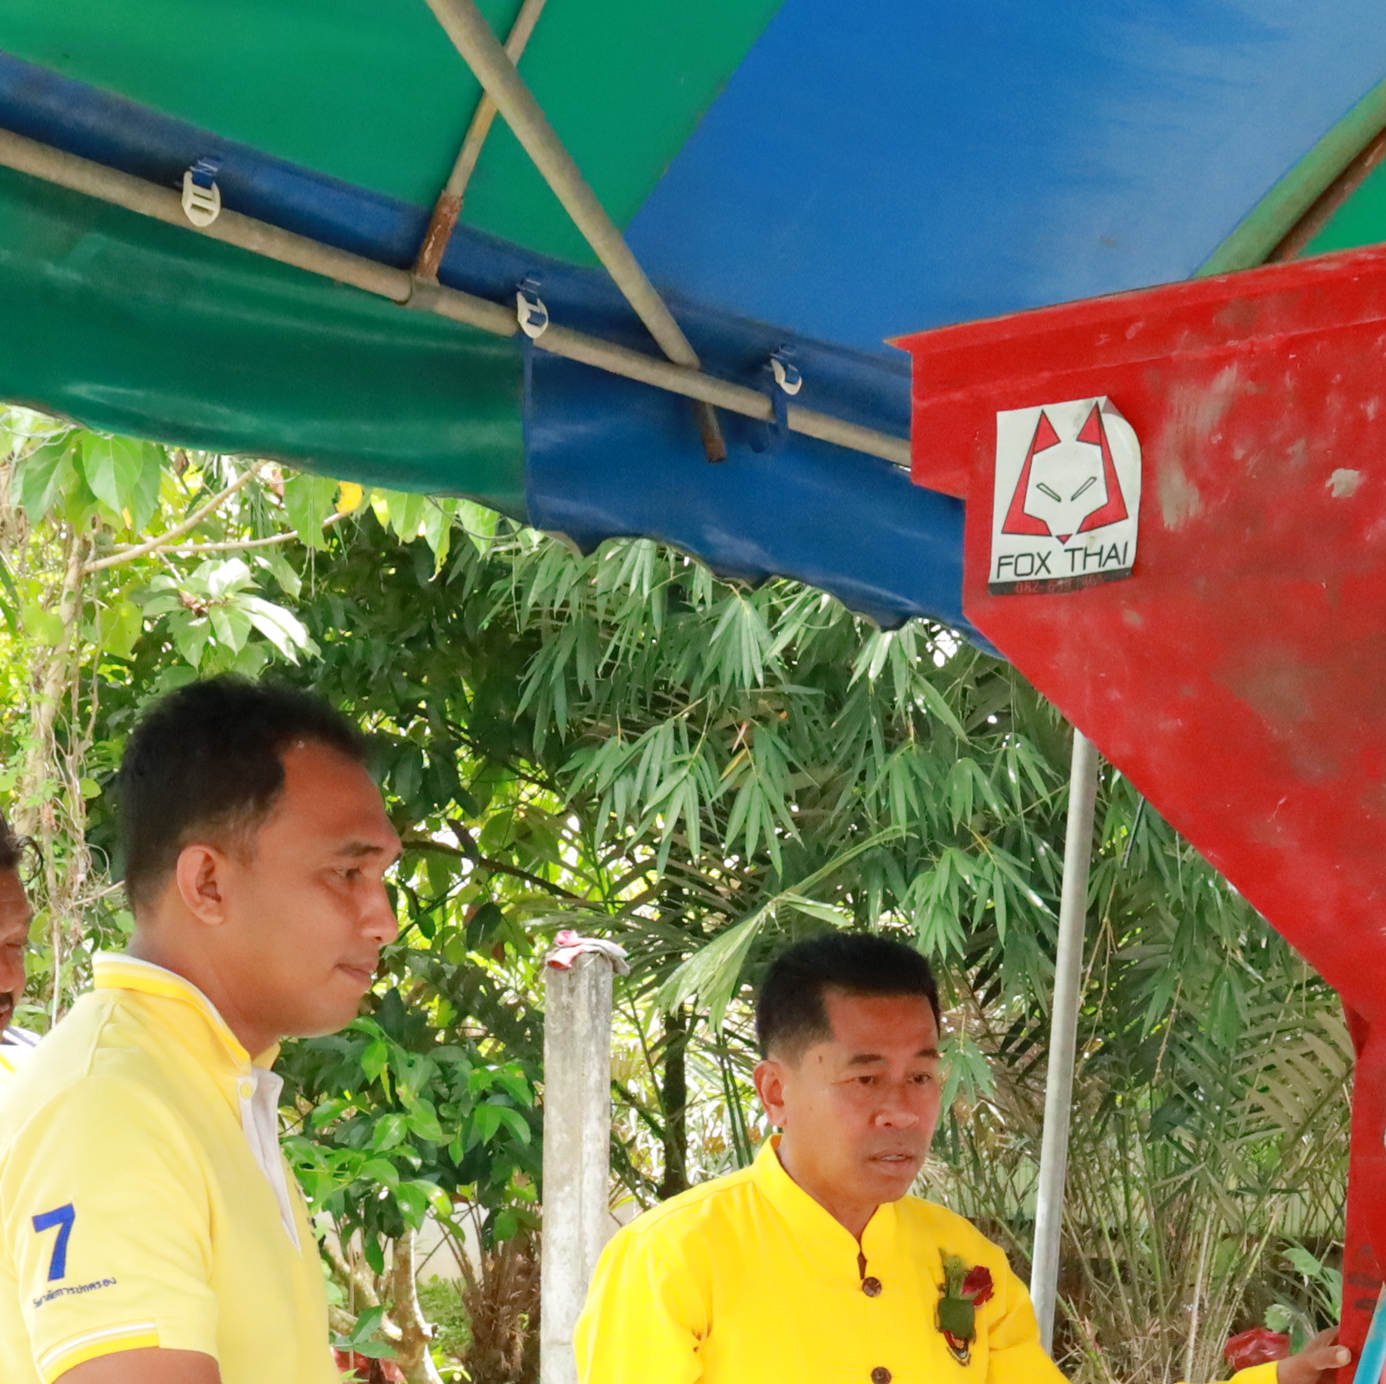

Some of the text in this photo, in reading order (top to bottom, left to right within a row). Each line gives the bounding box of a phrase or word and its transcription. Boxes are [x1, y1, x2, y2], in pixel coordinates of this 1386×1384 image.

[996, 541, 1128, 579] FOX THAI
[31, 1203, 75, 1282] 7
